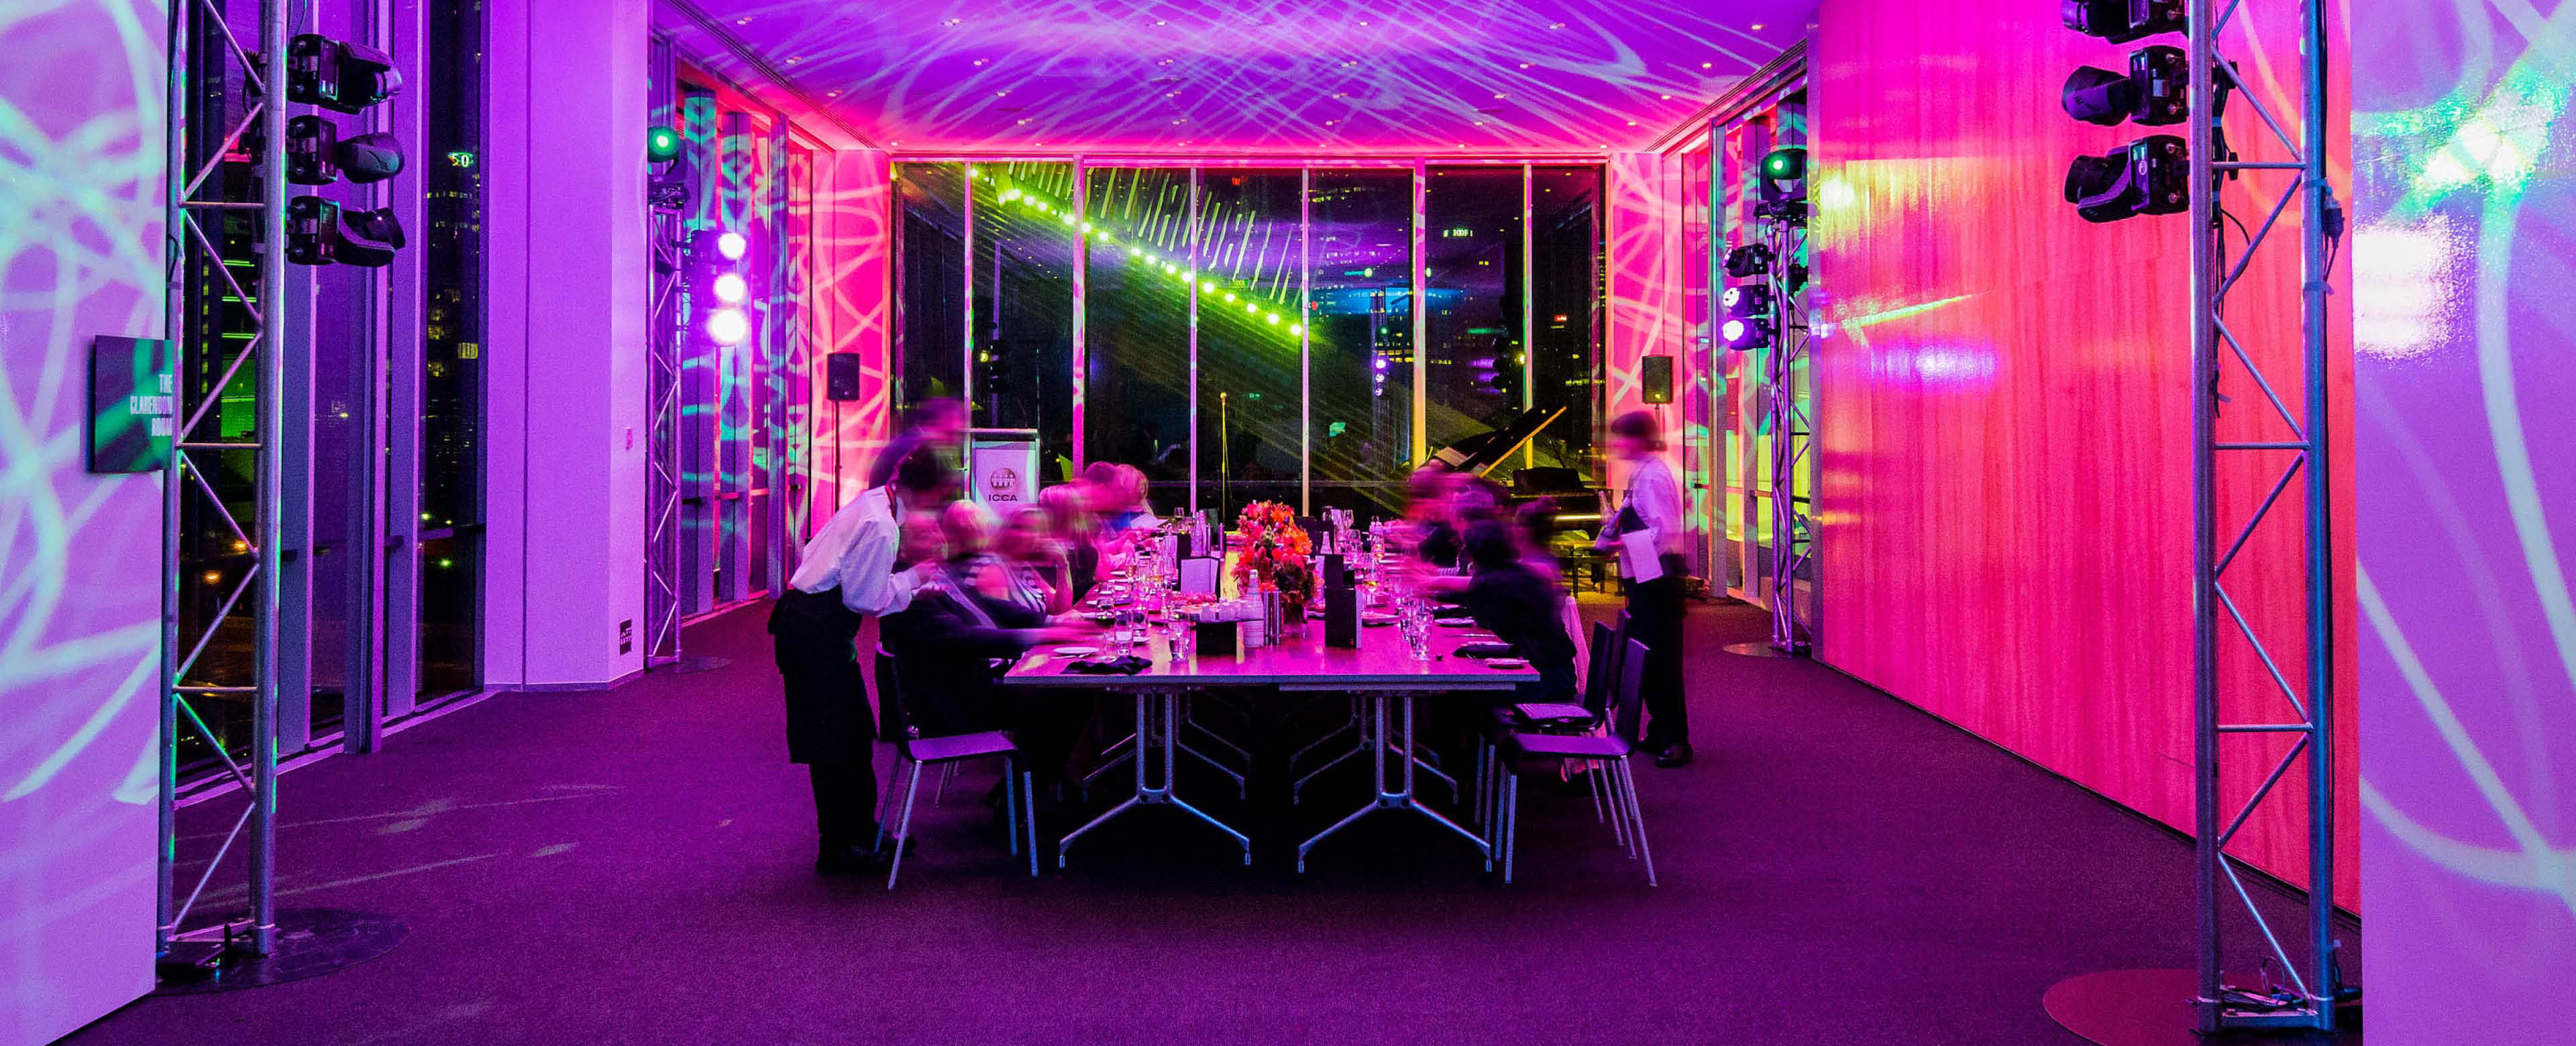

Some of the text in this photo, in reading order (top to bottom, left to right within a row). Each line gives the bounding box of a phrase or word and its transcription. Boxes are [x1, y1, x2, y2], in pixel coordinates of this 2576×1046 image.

[158, 373, 172, 393] THE
[130, 395, 173, 414] CLARENDON
[152, 418, 172, 437] ROOM
